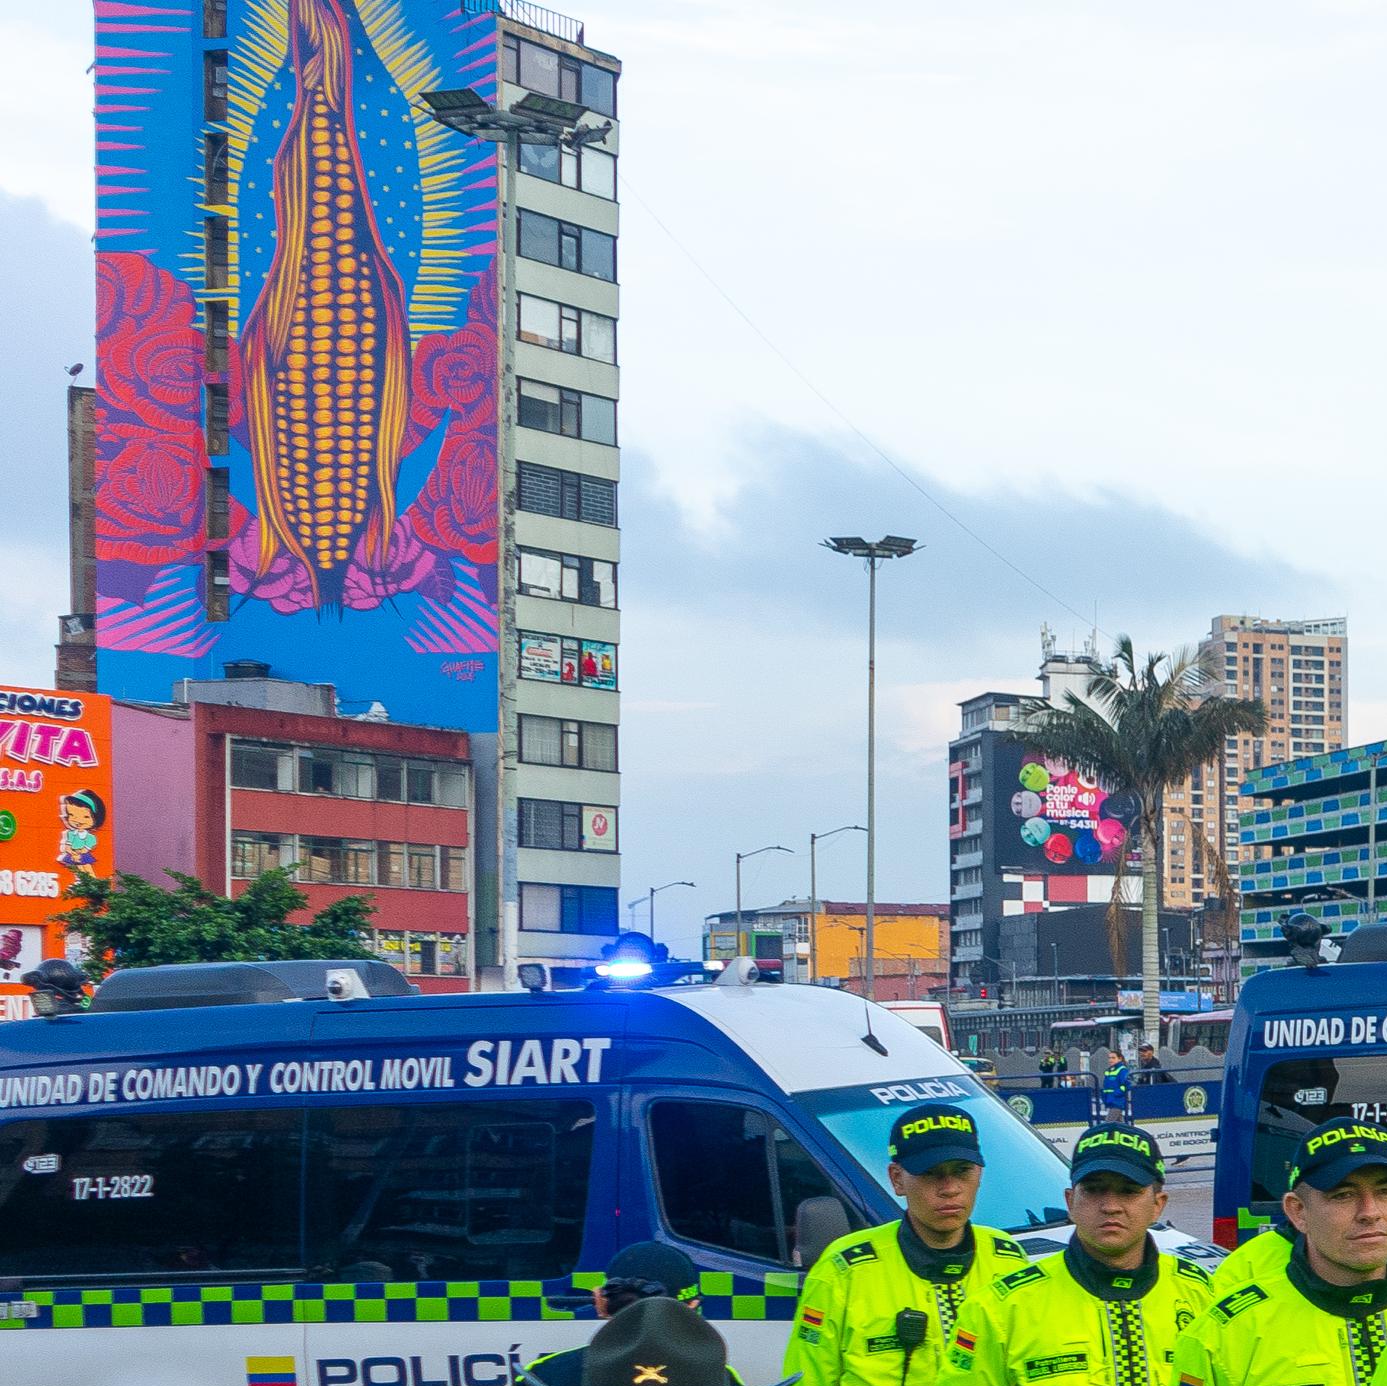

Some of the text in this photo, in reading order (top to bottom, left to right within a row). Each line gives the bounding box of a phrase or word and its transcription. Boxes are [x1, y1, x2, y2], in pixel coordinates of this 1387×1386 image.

[1264, 1018, 1344, 1048] UNIDAD
[1350, 1015, 1377, 1044] DE
[0, 1038, 611, 1108] UNIDAD DE COMANDO Y CONTROL MOVIL SIART
[869, 1079, 971, 1105] POLICÍA
[901, 1114, 972, 1139] POLICÍA
[1077, 1131, 1151, 1157] POLICÍA
[73, 1174, 153, 1200] 17-1-2822
